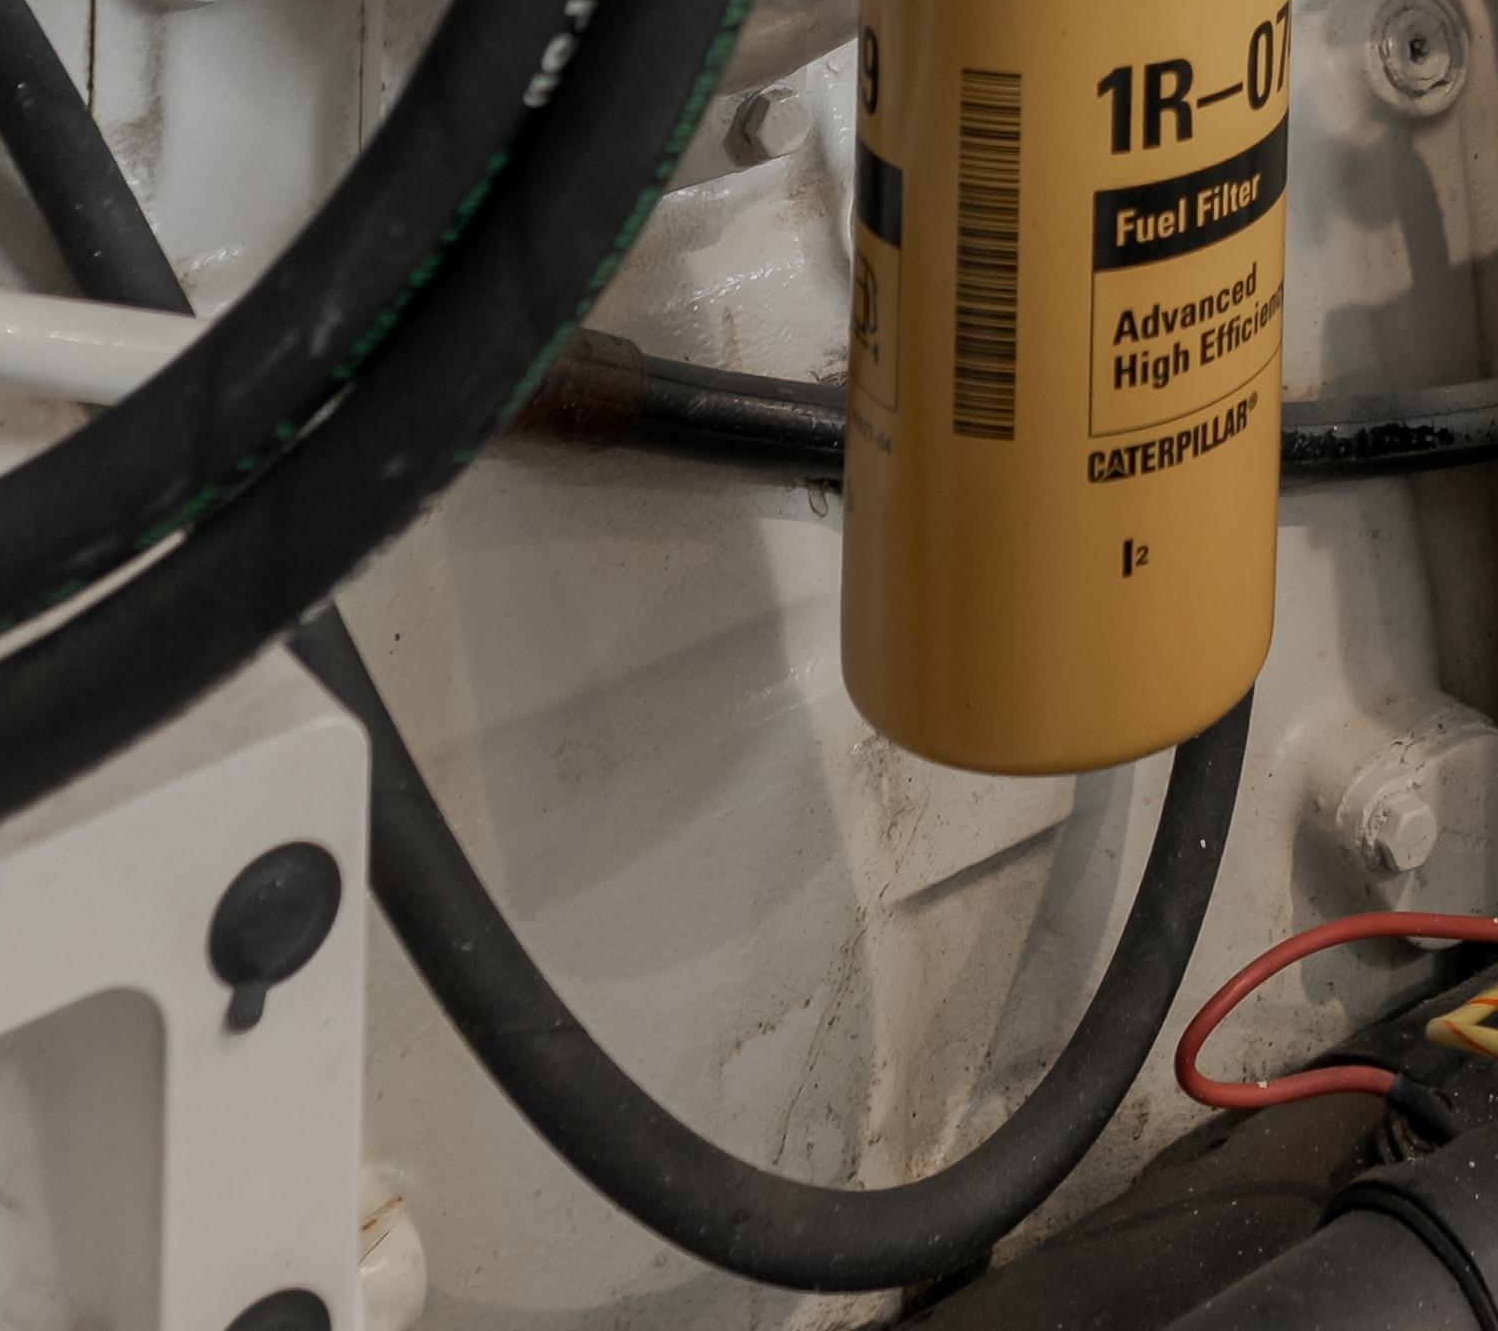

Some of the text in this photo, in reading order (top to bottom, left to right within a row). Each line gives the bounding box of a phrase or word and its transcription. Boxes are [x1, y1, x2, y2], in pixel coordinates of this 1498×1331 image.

[1115, 170, 1262, 248] Fuel Filter
[1112, 261, 1257, 347] Advanced
[1113, 341, 1190, 391] High
[1087, 395, 1250, 485] CATERPILLAR
